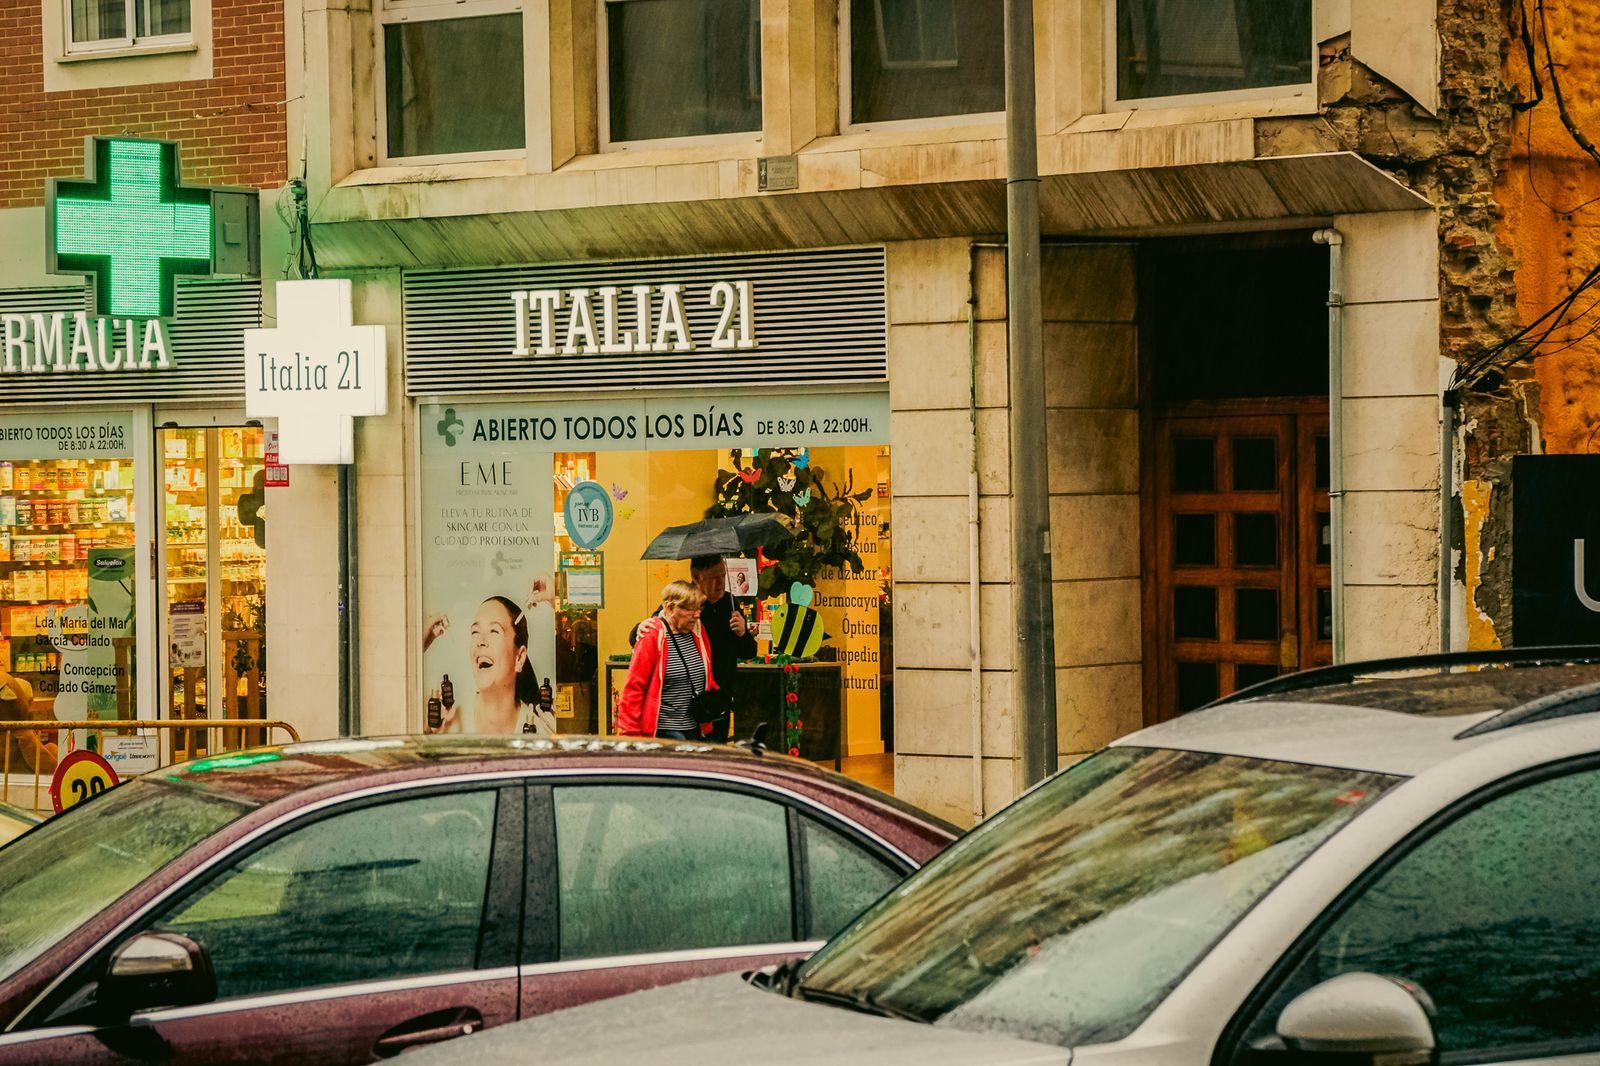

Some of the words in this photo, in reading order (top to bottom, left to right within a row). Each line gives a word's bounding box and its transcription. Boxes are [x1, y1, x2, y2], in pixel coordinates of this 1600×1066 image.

[511, 284, 695, 356] ITALIA
[710, 281, 758, 349] 21
[258, 352, 328, 391] Italia
[337, 350, 361, 390] 21
[472, 417, 557, 442] ABIERTO
[563, 415, 637, 440] TODOS
[645, 413, 685, 438] LOS
[693, 405, 744, 437] DÍAS
[757, 421, 773, 435] DE
[778, 420, 805, 435] 8:30
[809, 420, 819, 434] A
[823, 418, 872, 433] 22:00H.
[36, 426, 73, 440] TODOS
[76, 425, 96, 439] LOS
[99, 422, 124, 438] DÍAS
[58, 441, 69, 450] DE
[70, 440, 87, 450] 8:30
[89, 441, 95, 450] A
[97, 440, 127, 450] 22:00H.
[461, 461, 512, 485] EME
[441, 508, 469, 519] ELEVA
[471, 507, 483, 518] TU
[485, 507, 519, 518] RUTINA
[521, 507, 533, 518] DE
[578, 508, 599, 522] IVB
[446, 521, 488, 532] SKINCARE
[491, 521, 513, 532] CON
[515, 521, 529, 532] UN
[434, 535, 478, 546] CUIDADO
[480, 535, 540, 546] PROFESIONAL
[814, 591, 878, 612] Dermocaya
[35, 616, 57, 628] Lda.
[60, 616, 87, 629] María
[90, 617, 106, 629] del
[109, 617, 128, 629] Mar
[842, 613, 878, 638] Óptica
[35, 633, 68, 646] García
[71, 634, 110, 646] Collado
[64, 663, 125, 678] Concepción
[40, 680, 78, 693] Collado
[81, 681, 116, 694] Gámez
